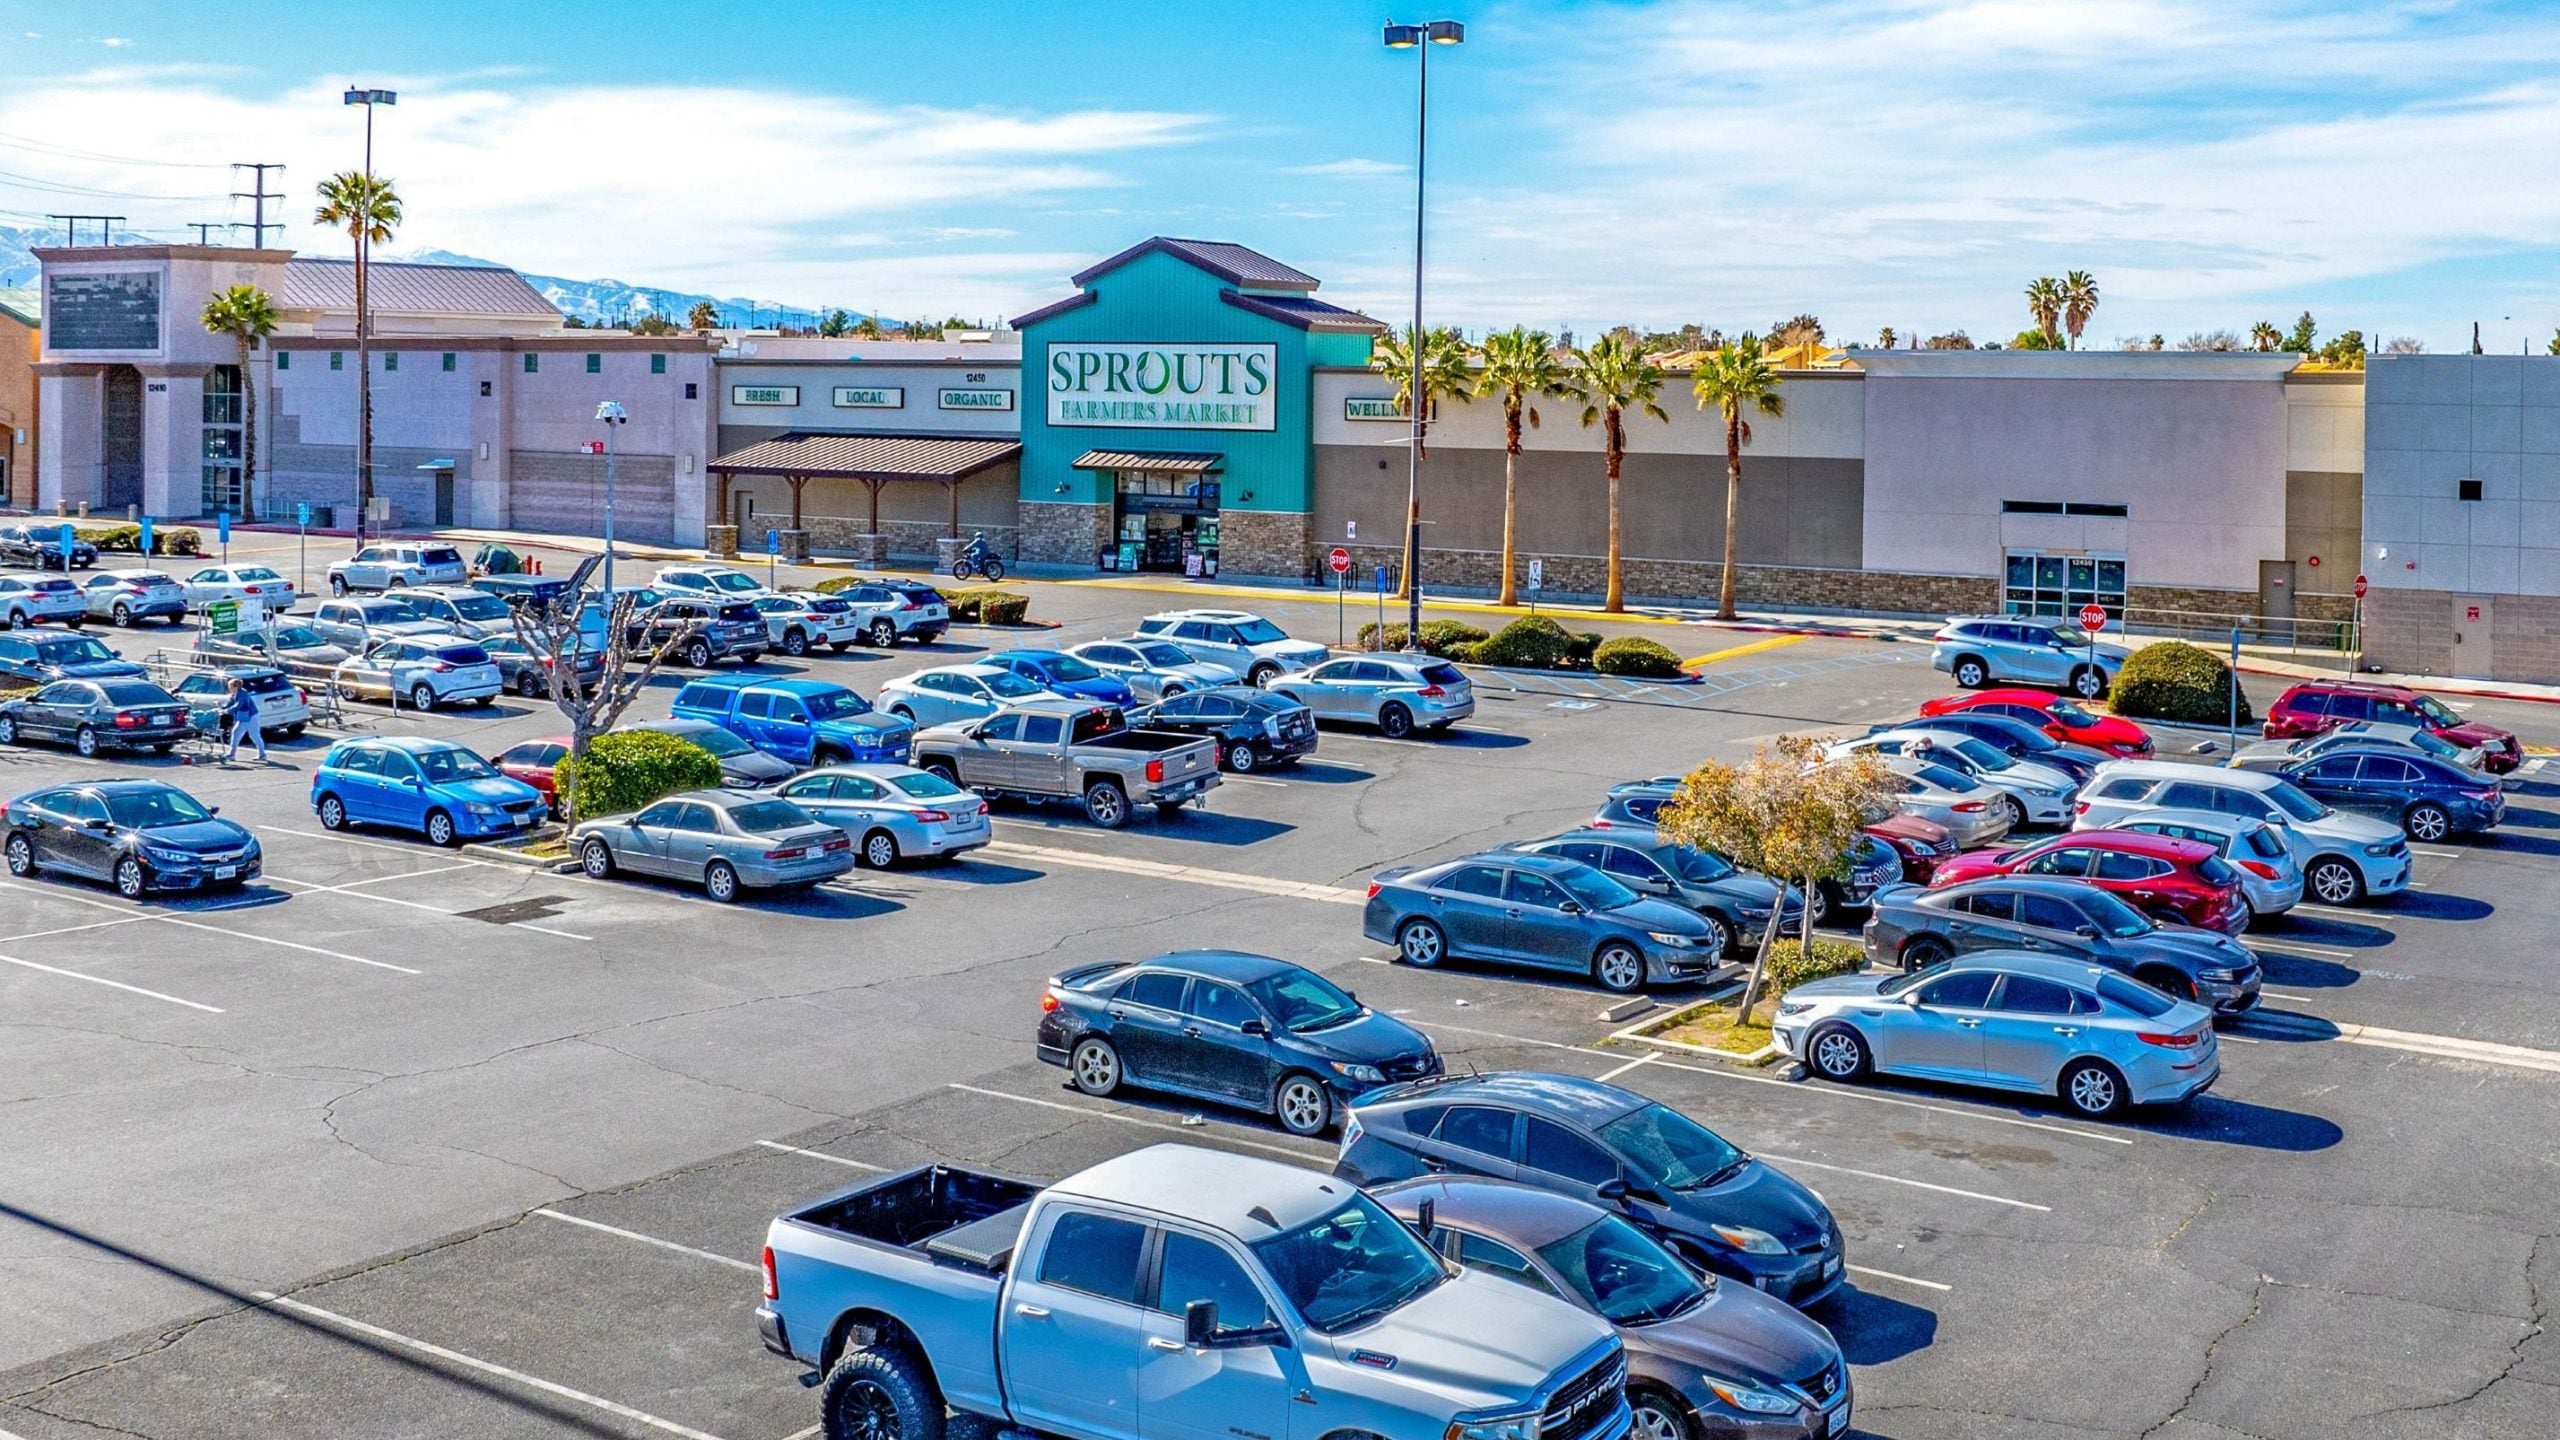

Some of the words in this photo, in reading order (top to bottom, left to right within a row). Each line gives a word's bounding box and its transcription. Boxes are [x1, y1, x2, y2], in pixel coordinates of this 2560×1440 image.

[966, 372, 986, 383] 12450
[1051, 350, 1268, 396] SPROUTS
[745, 389, 781, 402] FRESH
[846, 391, 886, 404] LOCAL
[944, 392, 1003, 407] ORGANIC
[1061, 400, 1158, 422] FARMERS
[1163, 401, 1258, 424] MARKET
[1347, 402, 1413, 417] WELLN
[1331, 555, 1348, 565] STOP
[2081, 611, 2105, 623] STOP
